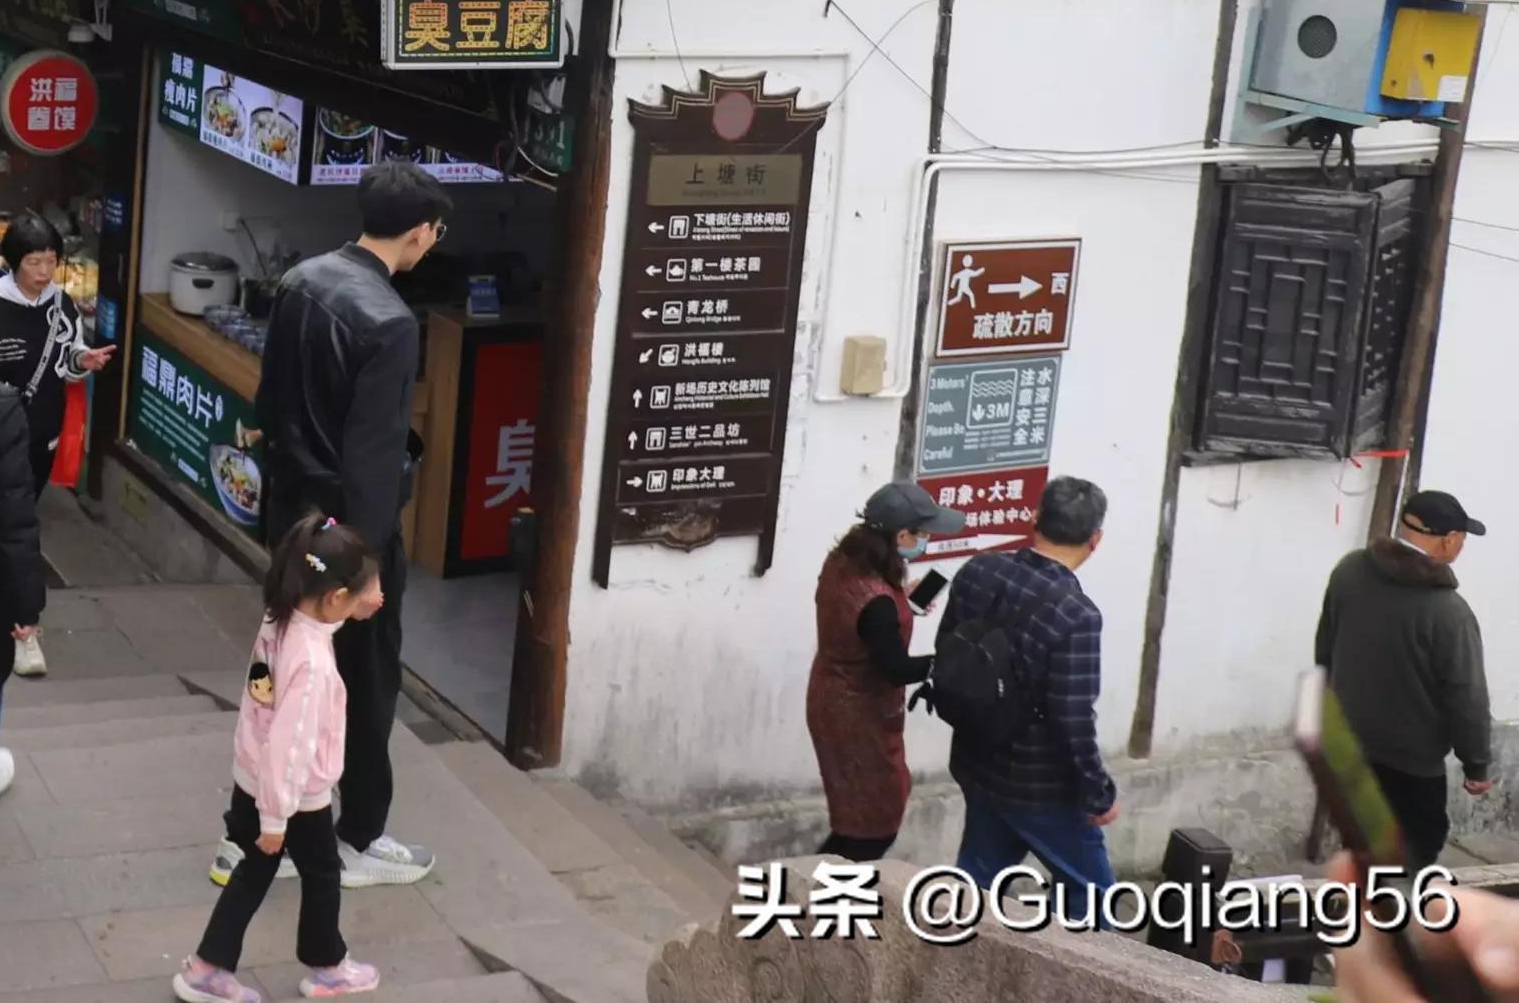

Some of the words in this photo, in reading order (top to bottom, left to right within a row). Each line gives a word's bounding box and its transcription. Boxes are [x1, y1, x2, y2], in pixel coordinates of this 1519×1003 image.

[30, 78, 77, 101] 洪福
[686, 163, 766, 184] 上塘街
[1051, 272, 1069, 294] 西
[972, 308, 1053, 339] 疏散方向
[142, 346, 213, 428] 福鼎肉片
[986, 402, 1010, 419] 3M
[1013, 368, 1036, 446] 注意安全
[1030, 366, 1053, 444] 水深三米
[673, 466, 725, 482] 印象大理
